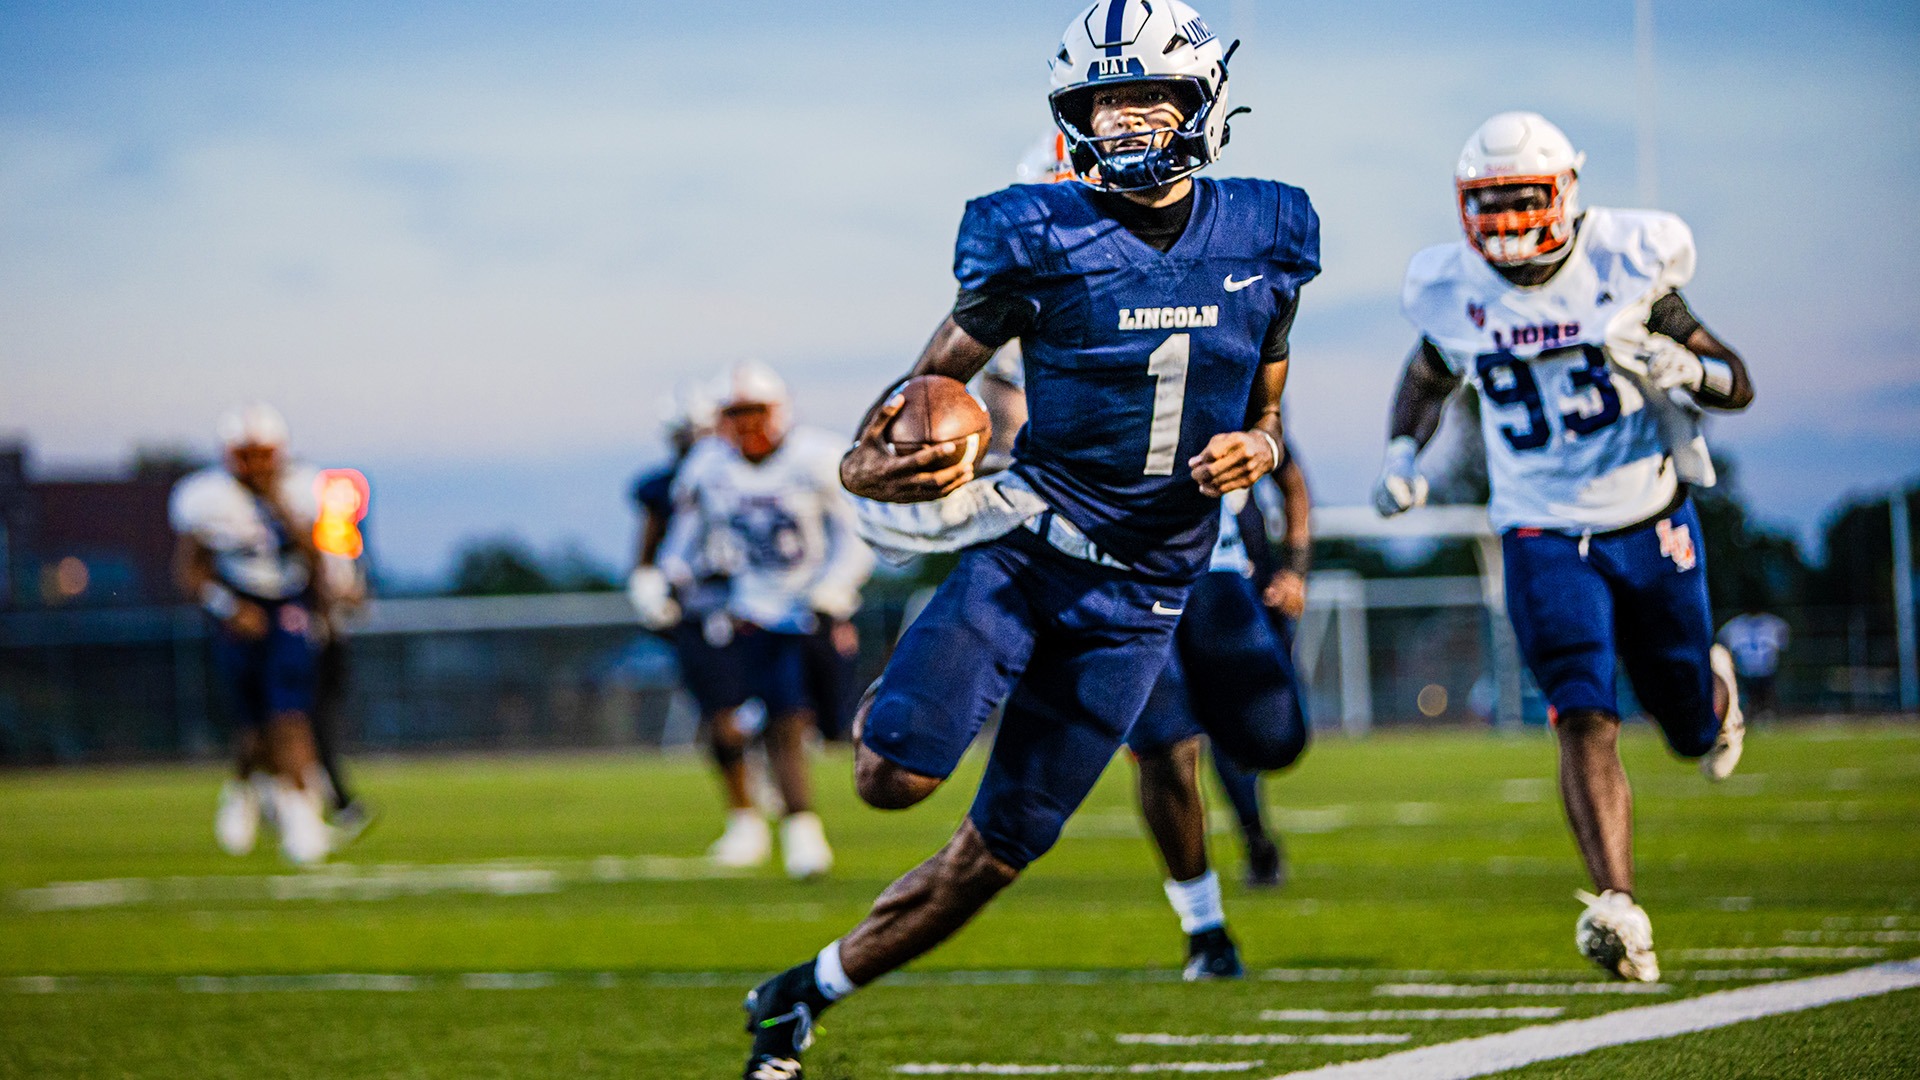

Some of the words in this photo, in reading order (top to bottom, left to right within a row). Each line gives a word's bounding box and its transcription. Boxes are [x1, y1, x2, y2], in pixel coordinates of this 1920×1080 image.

[1098, 57, 1129, 75] DAT
[1118, 305, 1219, 330] LINCOLN
[1143, 333, 1190, 476] 1
[1476, 343, 1621, 450] 93
